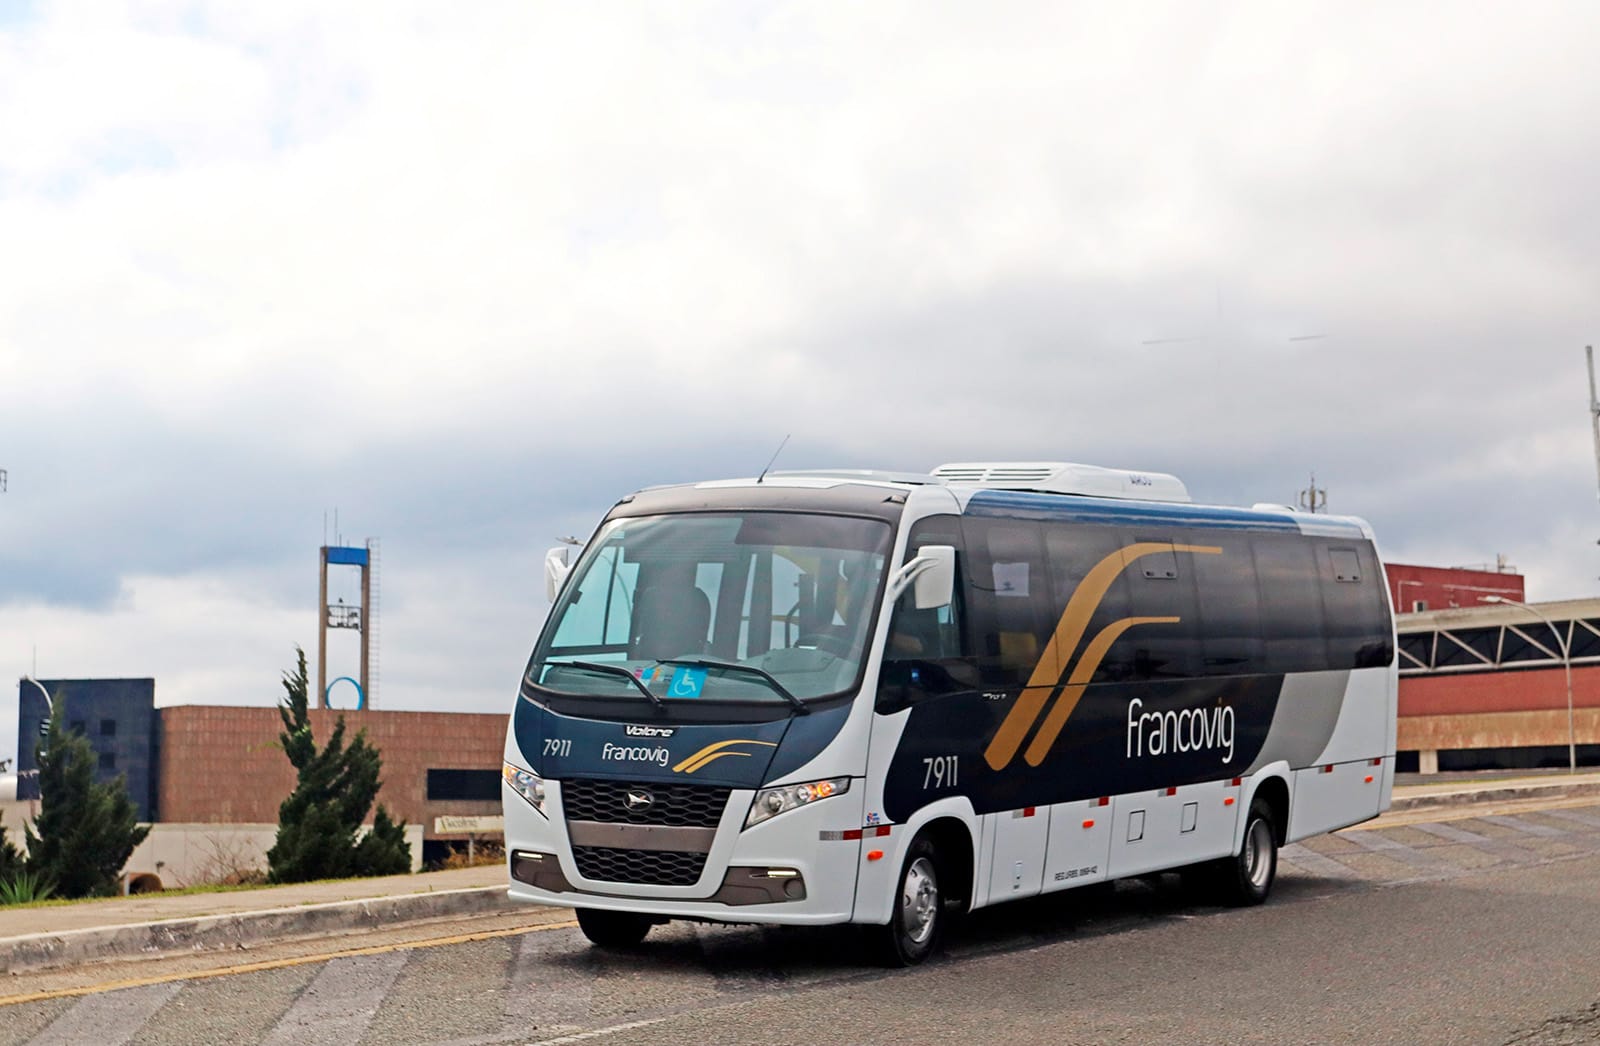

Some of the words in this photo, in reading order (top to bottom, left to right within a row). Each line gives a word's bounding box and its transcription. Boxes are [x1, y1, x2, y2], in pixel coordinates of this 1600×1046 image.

[625, 725, 673, 737] Volare
[1127, 697, 1235, 764] francovig
[542, 739, 572, 757] 7911
[602, 742, 669, 767] francovig
[923, 755, 958, 790] 7911
